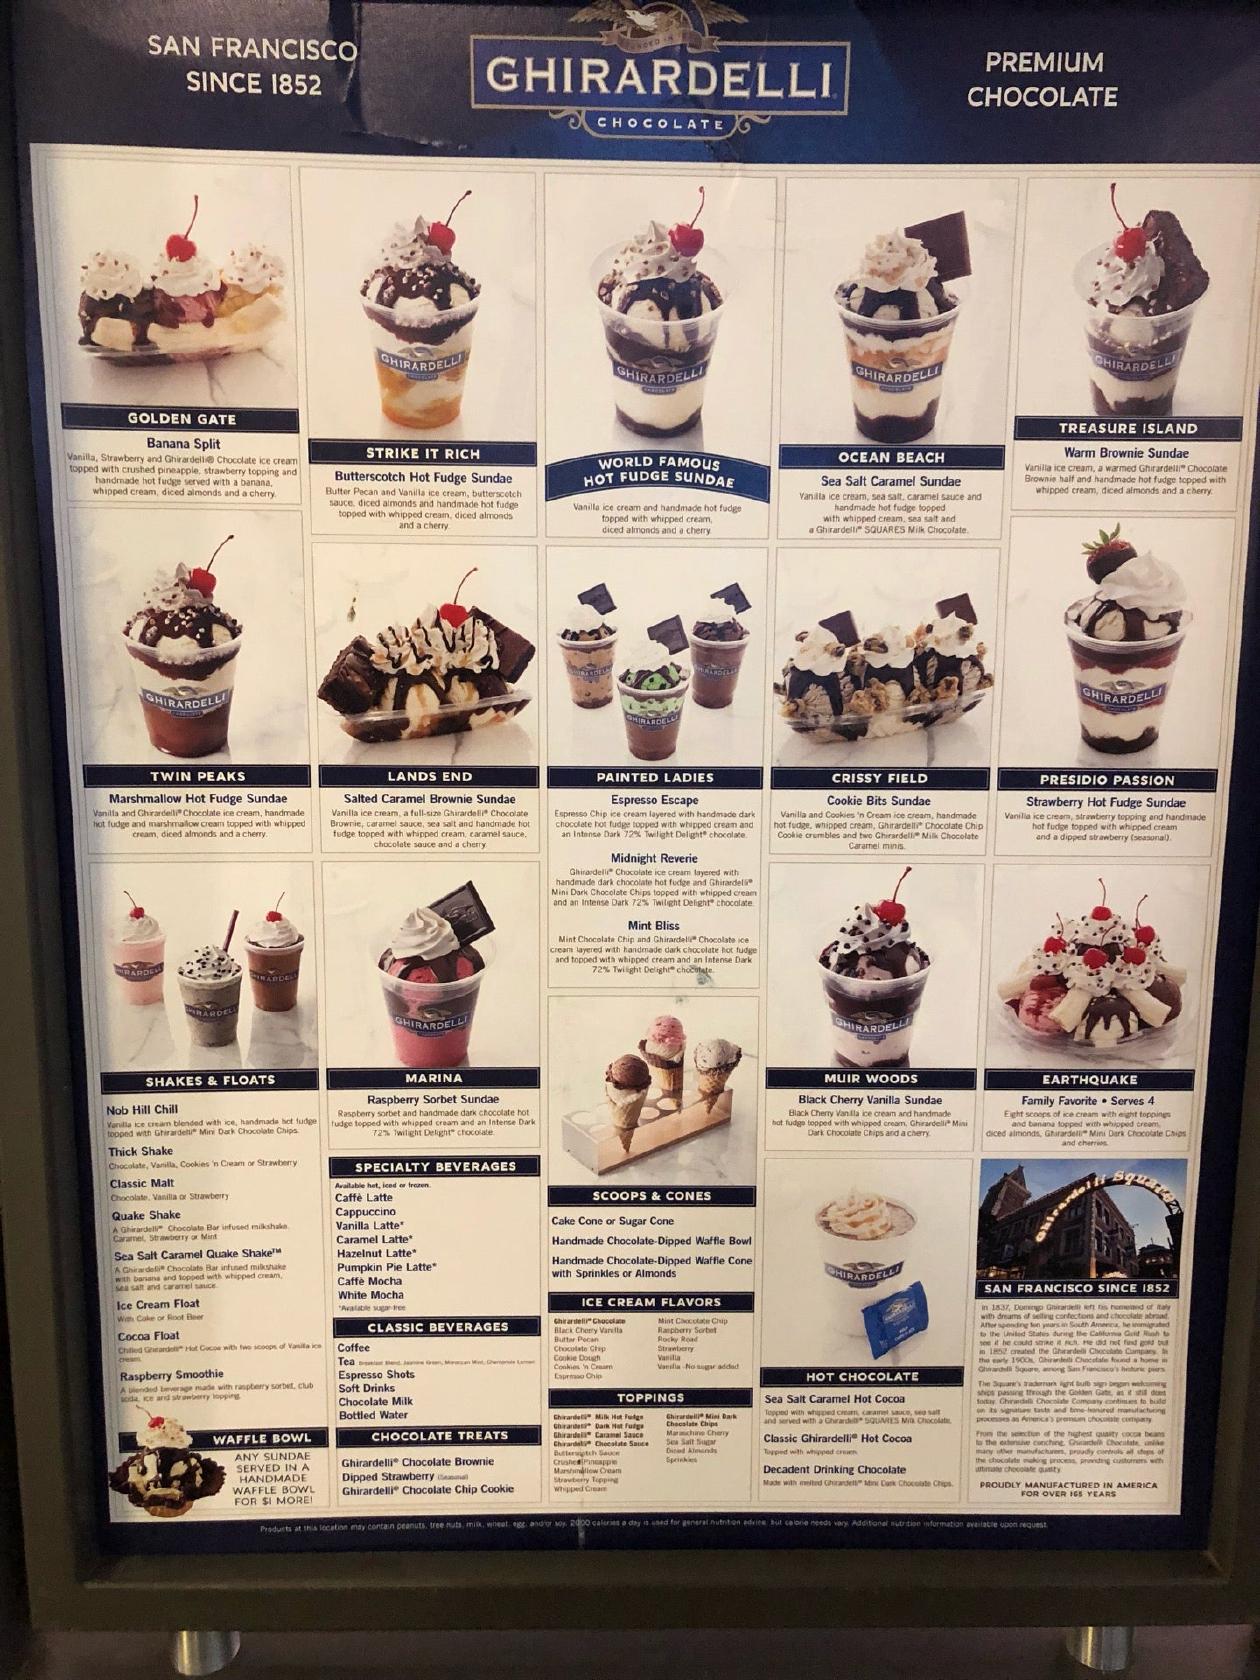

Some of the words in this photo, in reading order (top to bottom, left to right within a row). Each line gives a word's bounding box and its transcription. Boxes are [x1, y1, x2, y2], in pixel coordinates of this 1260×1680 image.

[148, 34, 200, 56] SAN
[211, 36, 357, 61] FRANCISCO
[986, 52, 1104, 72] PREMIUM
[186, 70, 262, 94] SINCE
[272, 73, 322, 96] 1852
[486, 56, 832, 99] GHIRARDELLI
[968, 87, 1118, 107] CHOCOLATE
[597, 116, 724, 131] CHOCOLATE
[381, 353, 463, 371] GHIRARDELLI
[616, 366, 705, 385] GHIRARDELLI
[855, 365, 940, 384] GHIRARDELLI
[128, 412, 191, 424] GOLDEN
[198, 414, 236, 425] GATE
[1059, 423, 1136, 434] TREASURE
[1143, 423, 1198, 434] ISLAND
[147, 437, 190, 449] Banana
[194, 438, 220, 452] Split
[367, 447, 419, 459] STRIKE
[426, 448, 439, 459] IT
[445, 448, 480, 460] RICH
[838, 452, 890, 463] OCEAN
[897, 452, 944, 463] BEACH
[1064, 447, 1096, 458] Warm
[1100, 447, 1144, 458] Brownie
[1148, 448, 1189, 459] Sundae
[598, 457, 653, 470] WORLD
[659, 456, 721, 472] FAMOUS
[335, 471, 405, 482] Butterscotch
[410, 472, 430, 482] Hot
[434, 472, 466, 486] Fudge
[472, 472, 512, 484] Sundae
[583, 473, 613, 487] HOT
[620, 471, 669, 482] FUDGE
[675, 471, 735, 488] SUNDAE
[822, 476, 841, 486] Sea
[846, 476, 866, 486] Salt
[871, 476, 915, 486] Caramel
[920, 476, 961, 486] Sundae
[643, 504, 658, 512] and
[704, 504, 717, 512] hot
[146, 692, 226, 709] GHIRARDELLI
[1082, 687, 1162, 704] GHIRARDELLI
[150, 772, 191, 781] TWIN
[198, 772, 245, 781] PEAKS
[388, 772, 436, 781] LANDS
[443, 772, 472, 781] END
[597, 773, 658, 782] PAINTED
[664, 773, 714, 782] LADIES
[832, 774, 882, 783] CRISSY
[888, 774, 928, 783] FIELD
[1040, 774, 1108, 785] PRESIDIO
[1114, 775, 1174, 786] PASSION
[109, 794, 182, 804] Marshmallow
[186, 794, 206, 803] Hot
[210, 794, 242, 806] Fudge
[247, 794, 288, 803] Sundae
[344, 794, 378, 803] Salted
[382, 794, 425, 804] Caramel
[430, 794, 472, 804] Brownie
[476, 794, 516, 804] Sundae
[612, 794, 657, 807] Espresso
[662, 794, 699, 807] Escape
[827, 795, 862, 806] Cookie
[866, 795, 887, 806] Bits
[892, 796, 931, 806] Sundae
[1026, 796, 1083, 809] Strawberry
[1088, 797, 1106, 807] Hot
[1110, 797, 1142, 809] Fudge
[1146, 797, 1186, 808] Sundae
[612, 853, 656, 865] Midnight
[661, 853, 698, 863] Reverie
[628, 920, 652, 930] Mint
[656, 920, 680, 930] Bliss
[146, 1076, 202, 1087] SHAKES
[224, 1075, 275, 1085] FLOATS
[406, 1074, 462, 1083] MARINA
[825, 1074, 860, 1083] MUIR
[866, 1074, 918, 1084] WOODS
[1043, 1075, 1138, 1086] EARTHQUAKE
[368, 1095, 419, 1107] Raspberry
[423, 1095, 457, 1104] Sorbet
[460, 1094, 500, 1104] Sundae
[799, 1095, 826, 1104] Black
[830, 1095, 864, 1106] Cherry
[867, 1095, 900, 1104] Vanilla
[905, 1095, 942, 1105] Sundae
[1022, 1096, 1054, 1108] Family
[1059, 1096, 1097, 1106] Favorite
[1111, 1096, 1144, 1106] Serves
[106, 1105, 129, 1116] Nob
[132, 1105, 150, 1115] Hill
[154, 1104, 178, 1114] Chill
[108, 1146, 137, 1158] Thick
[142, 1146, 173, 1156] Shake
[356, 1162, 430, 1173] SPECIALTY
[436, 1161, 516, 1172] BEVERAGES
[109, 1178, 146, 1189] Classic
[151, 1178, 174, 1188] Malt
[593, 1191, 646, 1200] SCOOPS
[666, 1192, 711, 1200] CONES
[336, 1207, 396, 1218] Cappuccino
[552, 1216, 575, 1225] Cake
[578, 1216, 603, 1225] Cone
[619, 1216, 647, 1227] Sugar
[650, 1216, 674, 1225] Cone
[984, 1284, 1012, 1293] SAN
[1018, 1284, 1093, 1293] FRANCISCO
[1098, 1284, 1137, 1292] SINCE
[1143, 1284, 1170, 1292] 1852
[582, 1298, 603, 1306] ICE
[608, 1298, 655, 1306] CREAM
[662, 1298, 721, 1306] FLAVORS
[368, 1323, 423, 1333] CLASSIC
[430, 1322, 508, 1332] BEVERAGES
[694, 1326, 717, 1334] Sorbet
[338, 1343, 370, 1352] Coffee
[338, 1356, 355, 1366] Tea
[120, 1371, 172, 1382] Raspberry
[176, 1368, 224, 1379] Smoothie
[339, 1370, 382, 1382] Espresso
[387, 1369, 415, 1379] Shots
[807, 1372, 835, 1382] HOT
[839, 1372, 918, 1381] CHOCOLATE
[617, 1393, 684, 1402] TOPPINGS
[765, 1395, 783, 1404] Sea
[787, 1394, 806, 1404] Salt
[809, 1394, 850, 1404] Caramel
[854, 1394, 872, 1403] Hot
[875, 1394, 905, 1403] Cocoa
[213, 1434, 266, 1445] WAFFLE
[272, 1433, 311, 1443] BOWL
[372, 1431, 452, 1442] CHOCOLATE
[458, 1431, 508, 1440] TREATS
[234, 1453, 259, 1461] ANY
[264, 1452, 310, 1461] SUNDAE
[764, 1465, 810, 1474] Decadent
[814, 1465, 854, 1476] Drinking
[858, 1465, 906, 1474] Chocolate
[240, 1474, 306, 1484] HANDMADE
